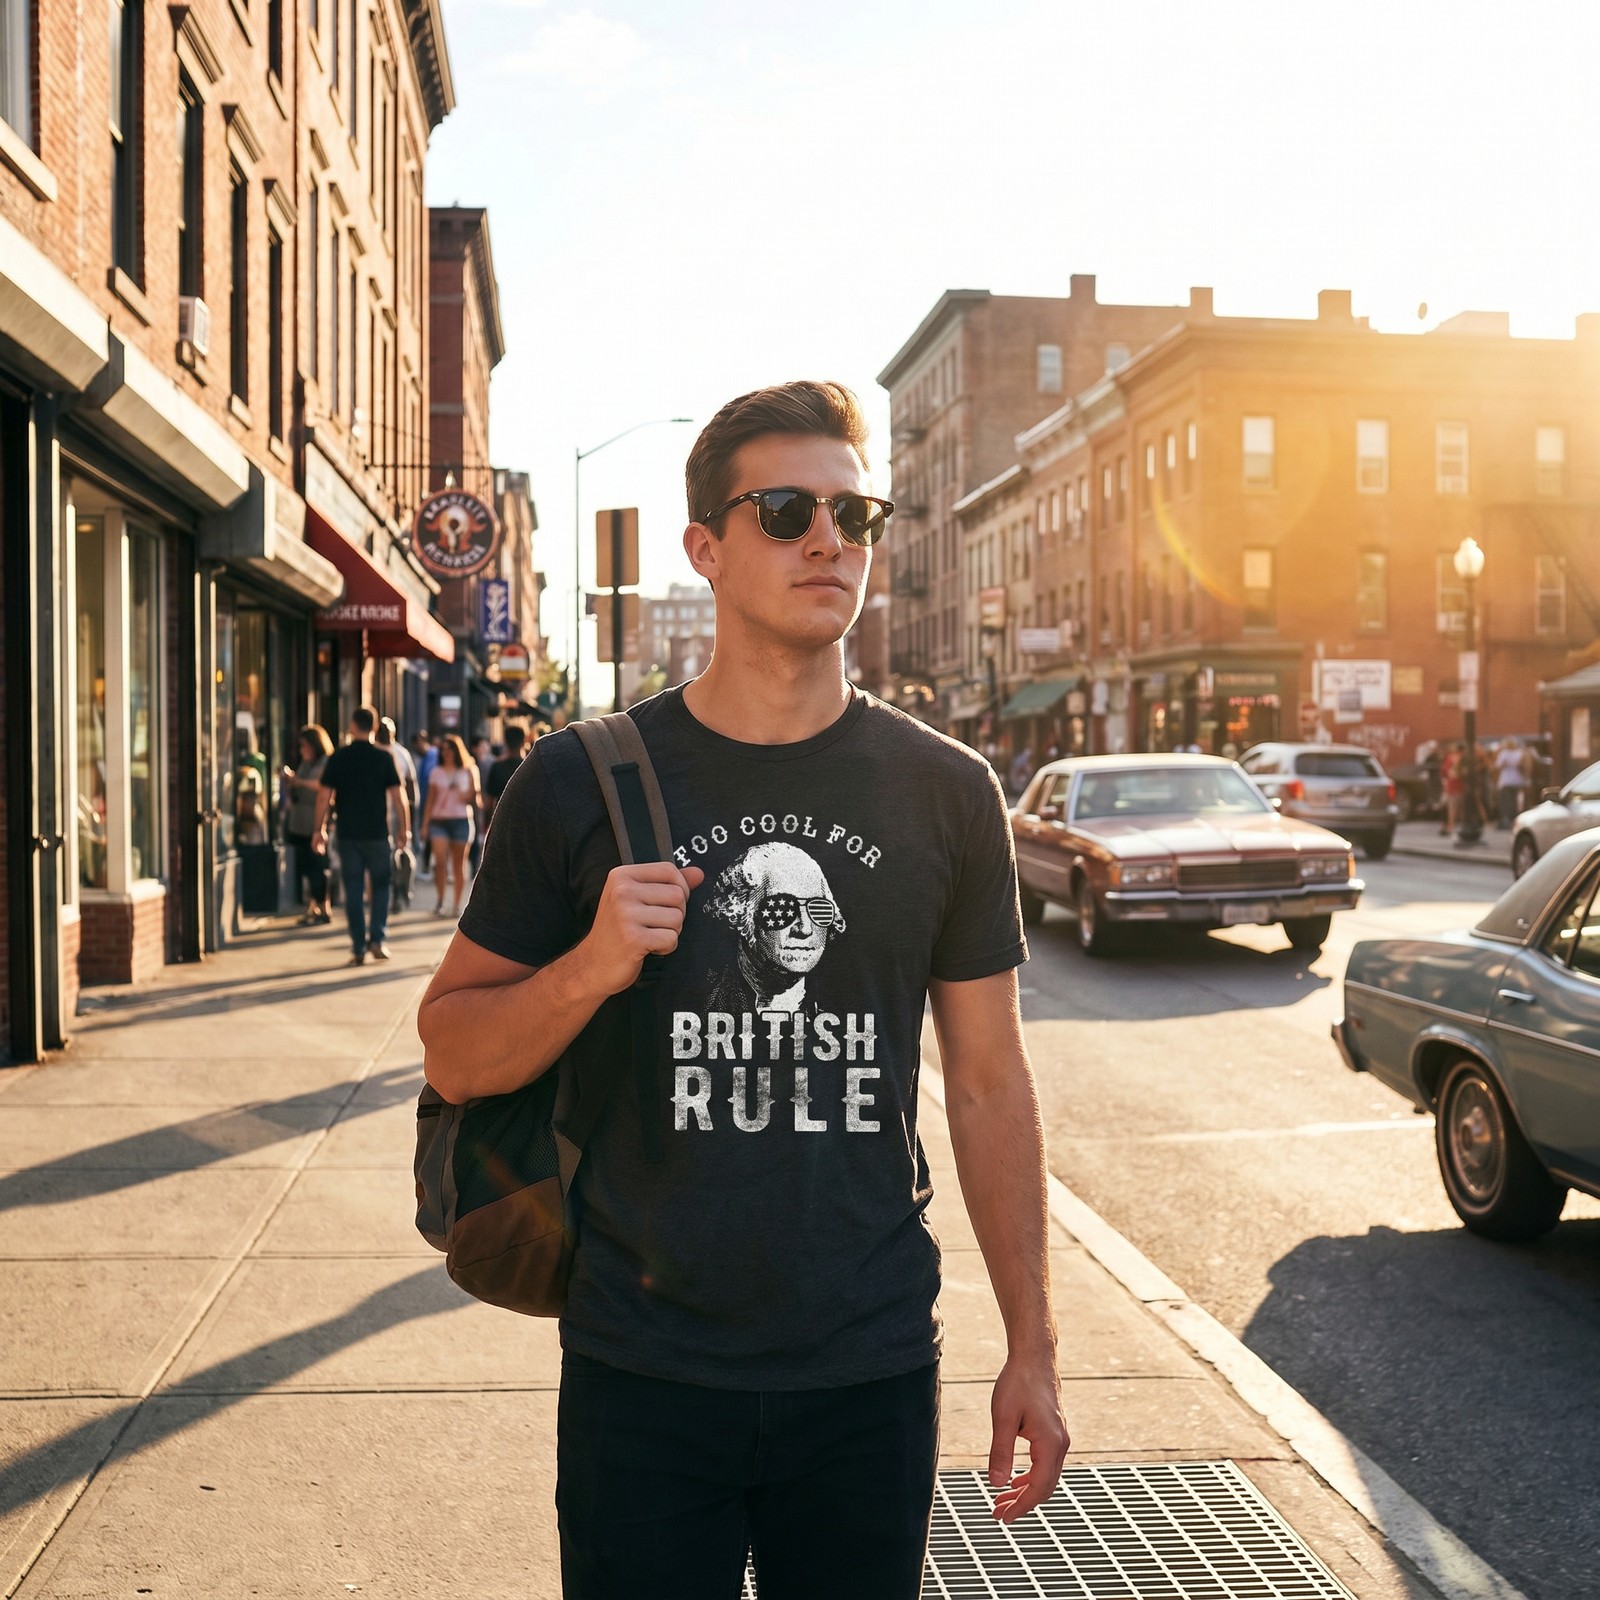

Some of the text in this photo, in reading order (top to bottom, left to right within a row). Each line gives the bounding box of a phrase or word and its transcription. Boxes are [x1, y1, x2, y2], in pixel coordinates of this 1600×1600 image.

[740, 814, 817, 838] COOL
[826, 824, 882, 869] FOR
[670, 1010, 878, 1062] BRITISH
[670, 1066, 880, 1132] RULE
